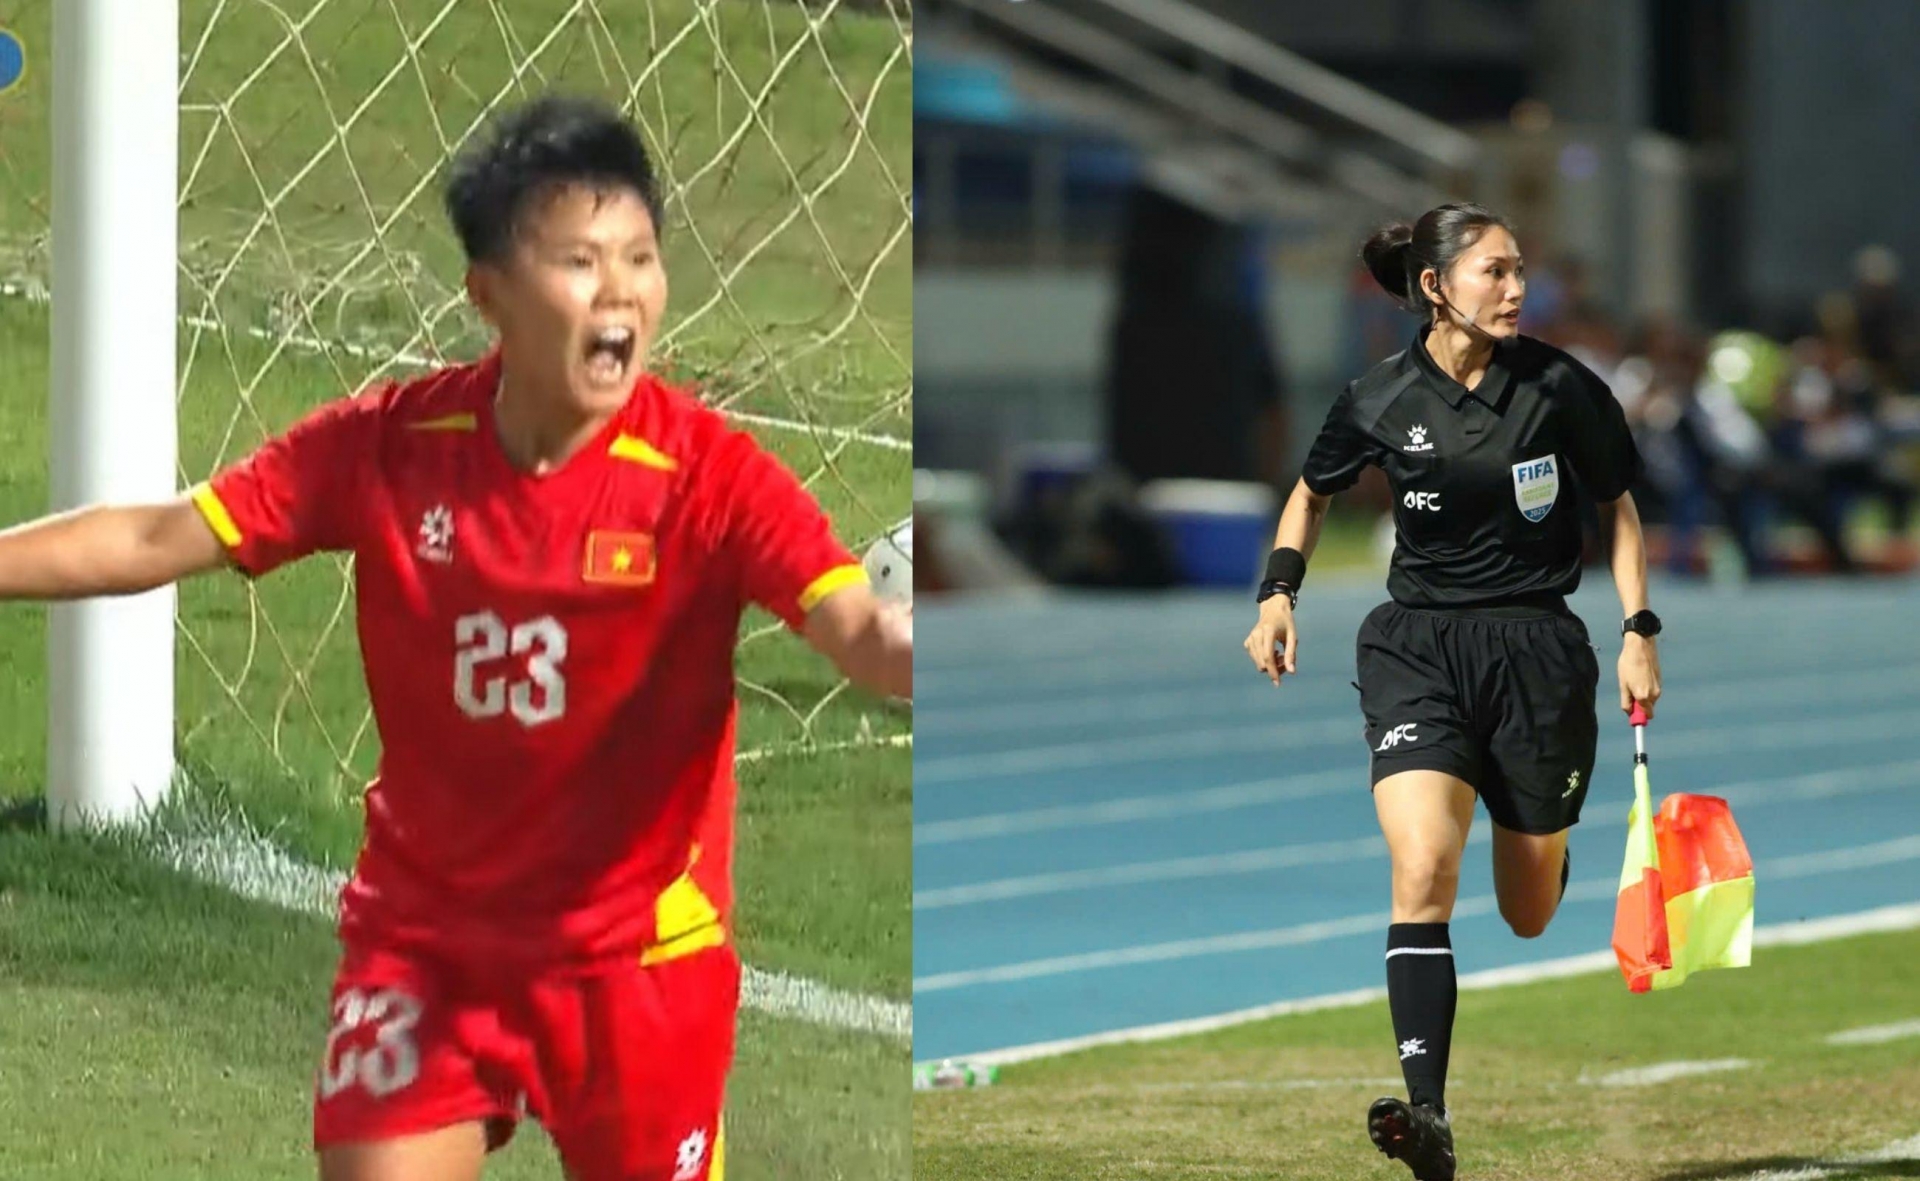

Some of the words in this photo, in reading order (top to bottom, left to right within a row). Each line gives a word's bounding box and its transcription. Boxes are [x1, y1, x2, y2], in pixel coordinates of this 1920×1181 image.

[1403, 442, 1434, 452] KELME
[1517, 460, 1554, 483] FIFA
[1403, 490, 1441, 512] AFC
[1530, 506, 1546, 518] 2025
[454, 609, 568, 728] 23
[1374, 723, 1418, 752] AFC
[320, 988, 424, 1099] 23
